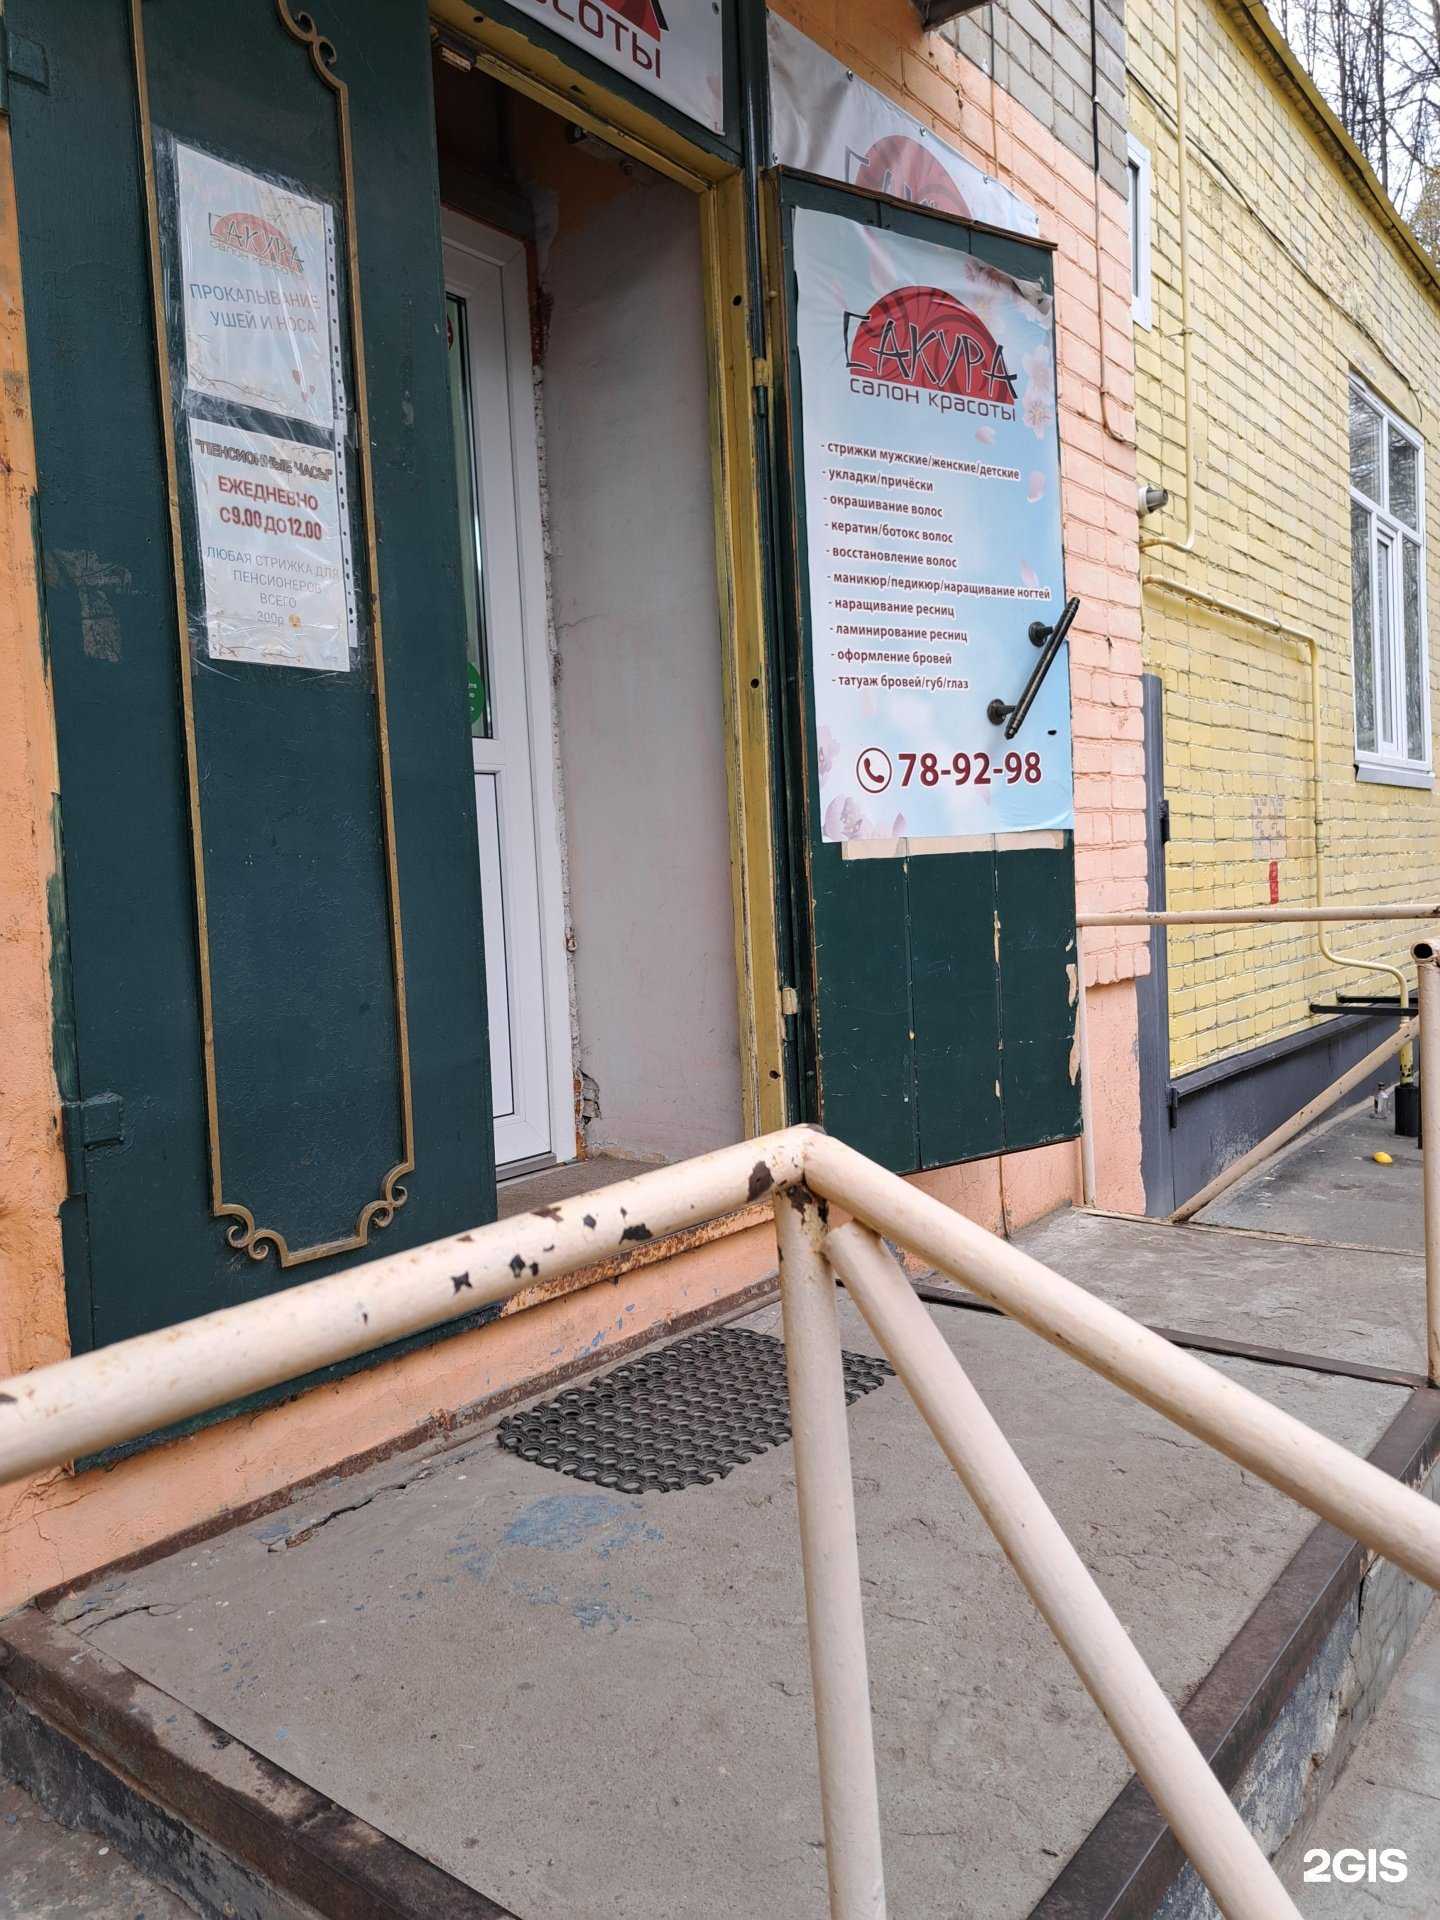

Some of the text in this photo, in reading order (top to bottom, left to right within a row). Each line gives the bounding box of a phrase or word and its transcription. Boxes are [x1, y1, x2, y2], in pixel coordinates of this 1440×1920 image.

[536, 0, 661, 79] соты
[190, 283, 321, 309] ПРОКАЛЫВАНИЕ
[210, 310, 317, 333] УШЕЙ И НОСА
[843, 311, 1018, 399] САКУРА
[850, 377, 1016, 422] салон красоты
[827, 442, 877, 458] стрижки
[880, 449, 1020, 480] мужские/женские/детские
[828, 468, 934, 492] укладки/причёски
[218, 475, 318, 511] ЕЖЕДНЕВНО
[830, 495, 909, 513] окрашивание
[911, 505, 943, 518] волос
[831, 521, 920, 539] кератин/ботокс
[922, 531, 953, 543] волос
[207, 547, 252, 564] ЛЮБАЯ
[256, 555, 313, 575] СТРИЖКА
[832, 547, 924, 564] восстановление
[926, 556, 957, 568] волос
[833, 573, 1015, 597] маникюр/педикюр/наращивание
[1017, 587, 1050, 599] ногтей
[259, 592, 297, 608] ВСЕГО
[834, 599, 913, 614] наращивание
[916, 605, 955, 618] ресниц
[836, 625, 927, 640] ламинирование
[929, 630, 968, 643] ресниц
[837, 648, 910, 663] оформление
[912, 651, 952, 665] бровей
[838, 676, 878, 688] татуаж
[880, 675, 969, 690] бровей/губ/глаз
[898, 752, 1042, 787] 78-92-98
